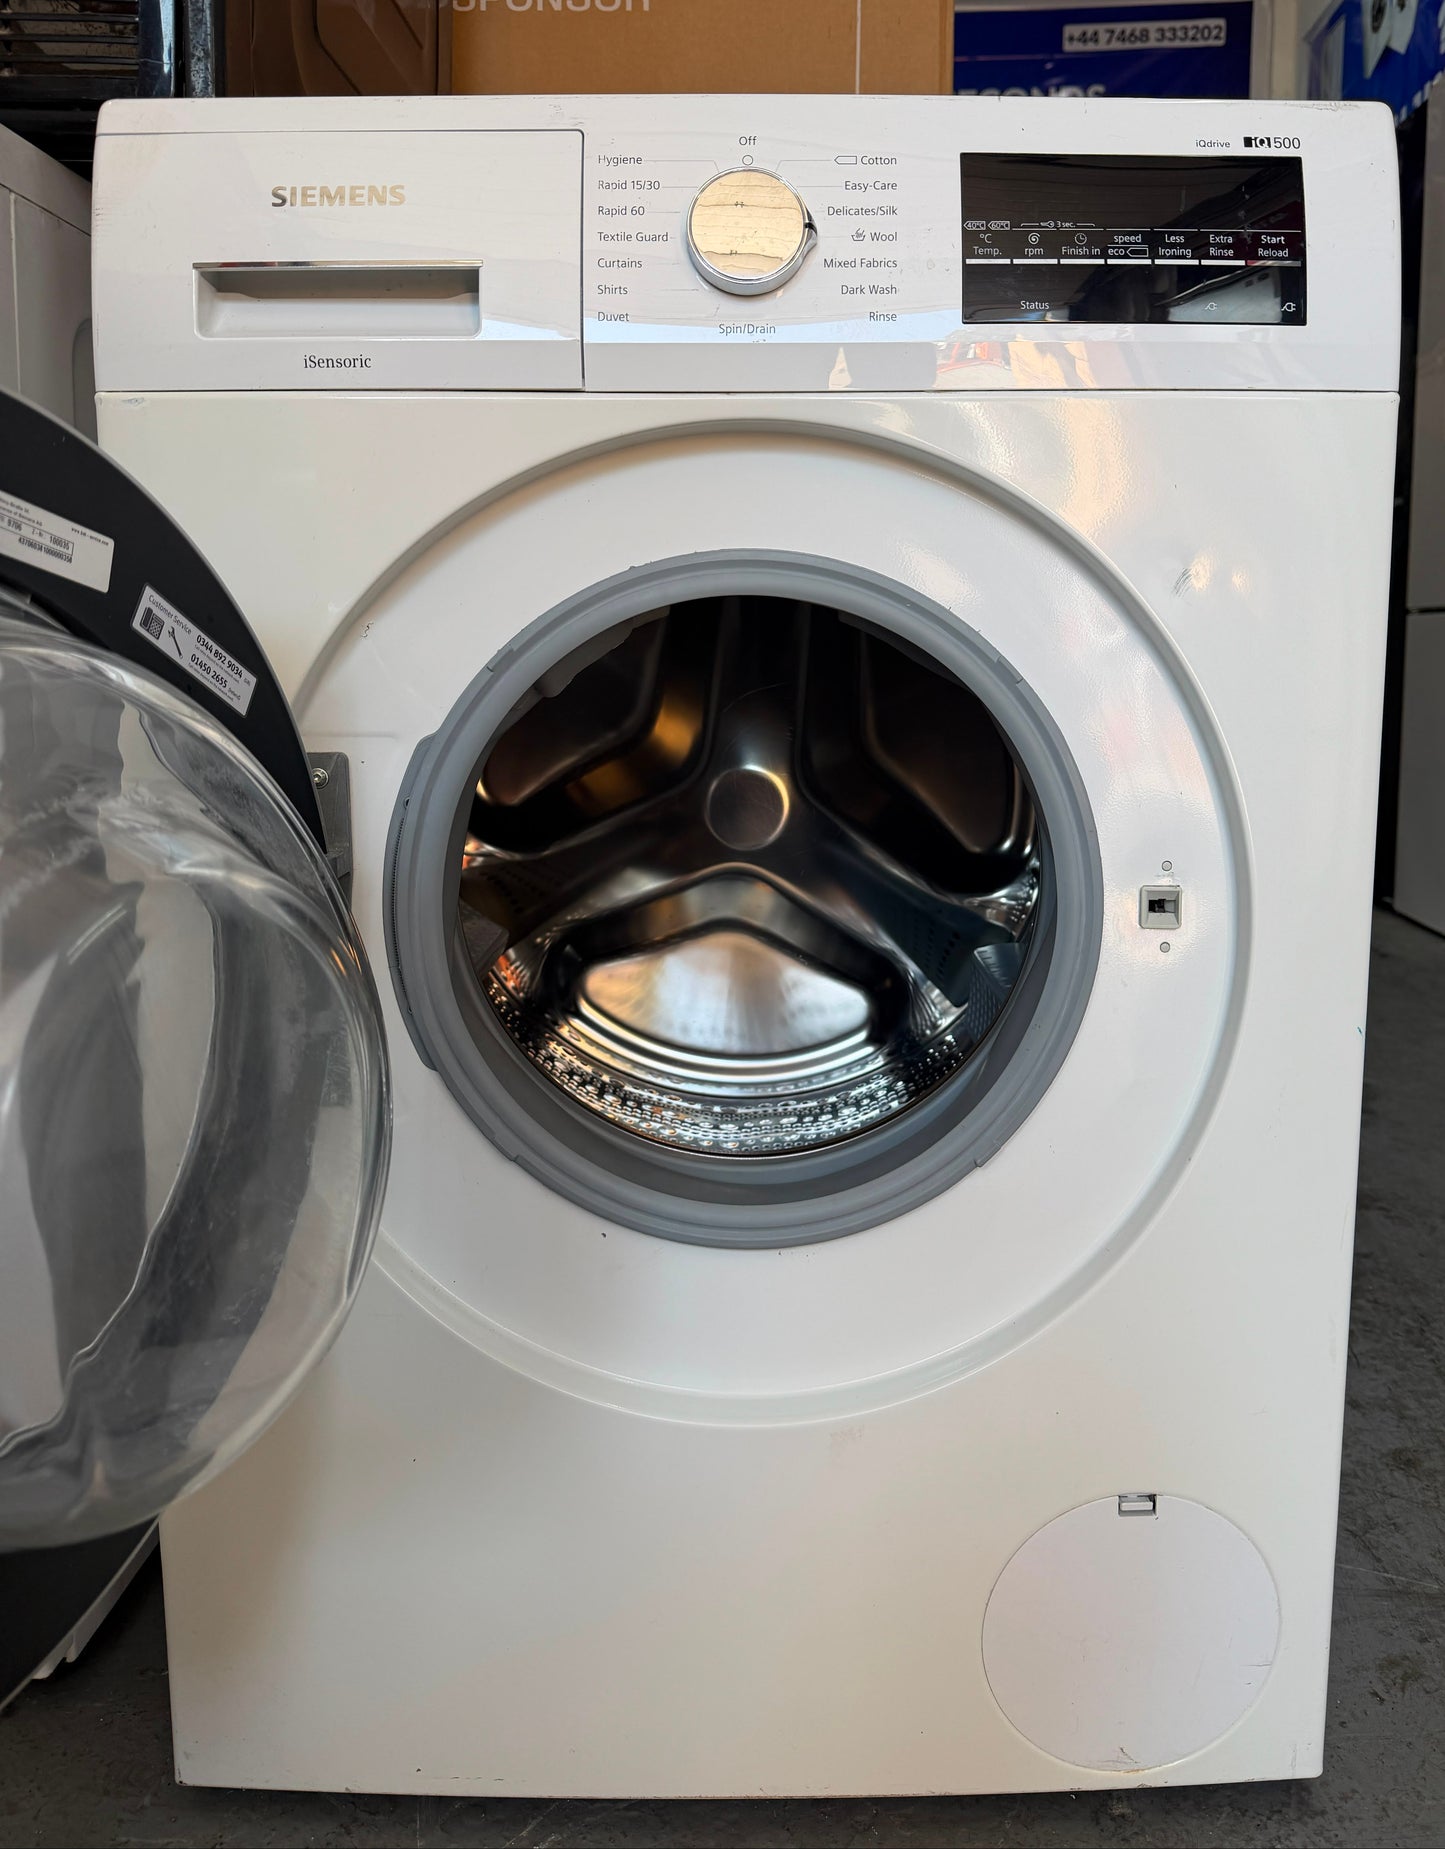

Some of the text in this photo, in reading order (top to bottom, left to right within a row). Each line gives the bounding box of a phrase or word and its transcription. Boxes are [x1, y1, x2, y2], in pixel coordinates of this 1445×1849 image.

[1067, 25, 1223, 46] +44 7468 333202
[739, 136, 757, 146] Off
[1195, 139, 1231, 149] iQdrive
[598, 155, 643, 167] Hygiene
[861, 155, 897, 166] Cotton
[598, 180, 660, 192] Rapid 15/30
[844, 181, 898, 192] Easy-Care
[271, 184, 406, 207] SIEMENS
[598, 206, 645, 218] Rapid 60
[827, 205, 898, 217] Delicates/Silk
[597, 231, 668, 242] Textile Guard
[870, 231, 898, 242] Wool
[1113, 233, 1141, 245] speed
[1165, 234, 1185, 243] Less
[1209, 234, 1233, 244] Extra
[1261, 235, 1285, 244] Start
[973, 246, 1002, 257] Temp.
[1024, 247, 1044, 257] rpm
[1061, 246, 1101, 255] Finish in
[1108, 248, 1125, 256] eco
[1158, 247, 1192, 258] Ironing
[1209, 247, 1234, 256] Rinse
[1258, 248, 1289, 257] Reload
[597, 258, 643, 269] Curtains
[823, 258, 898, 269] Mixed Fabrics
[597, 284, 628, 295] Shirts
[841, 284, 897, 295] Dark Wash
[1020, 300, 1050, 311] Status
[597, 312, 630, 323] Duvet
[869, 311, 897, 322] Rinse
[719, 323, 776, 336] Spin/Drain
[303, 354, 372, 369] iSensoric
[148, 594, 192, 635] Customer Service
[196, 634, 213, 654] 0344
[213, 649, 227, 665] 892
[227, 660, 243, 679] 9034
[190, 653, 212, 675] 01450
[211, 670, 228, 689] 2655
